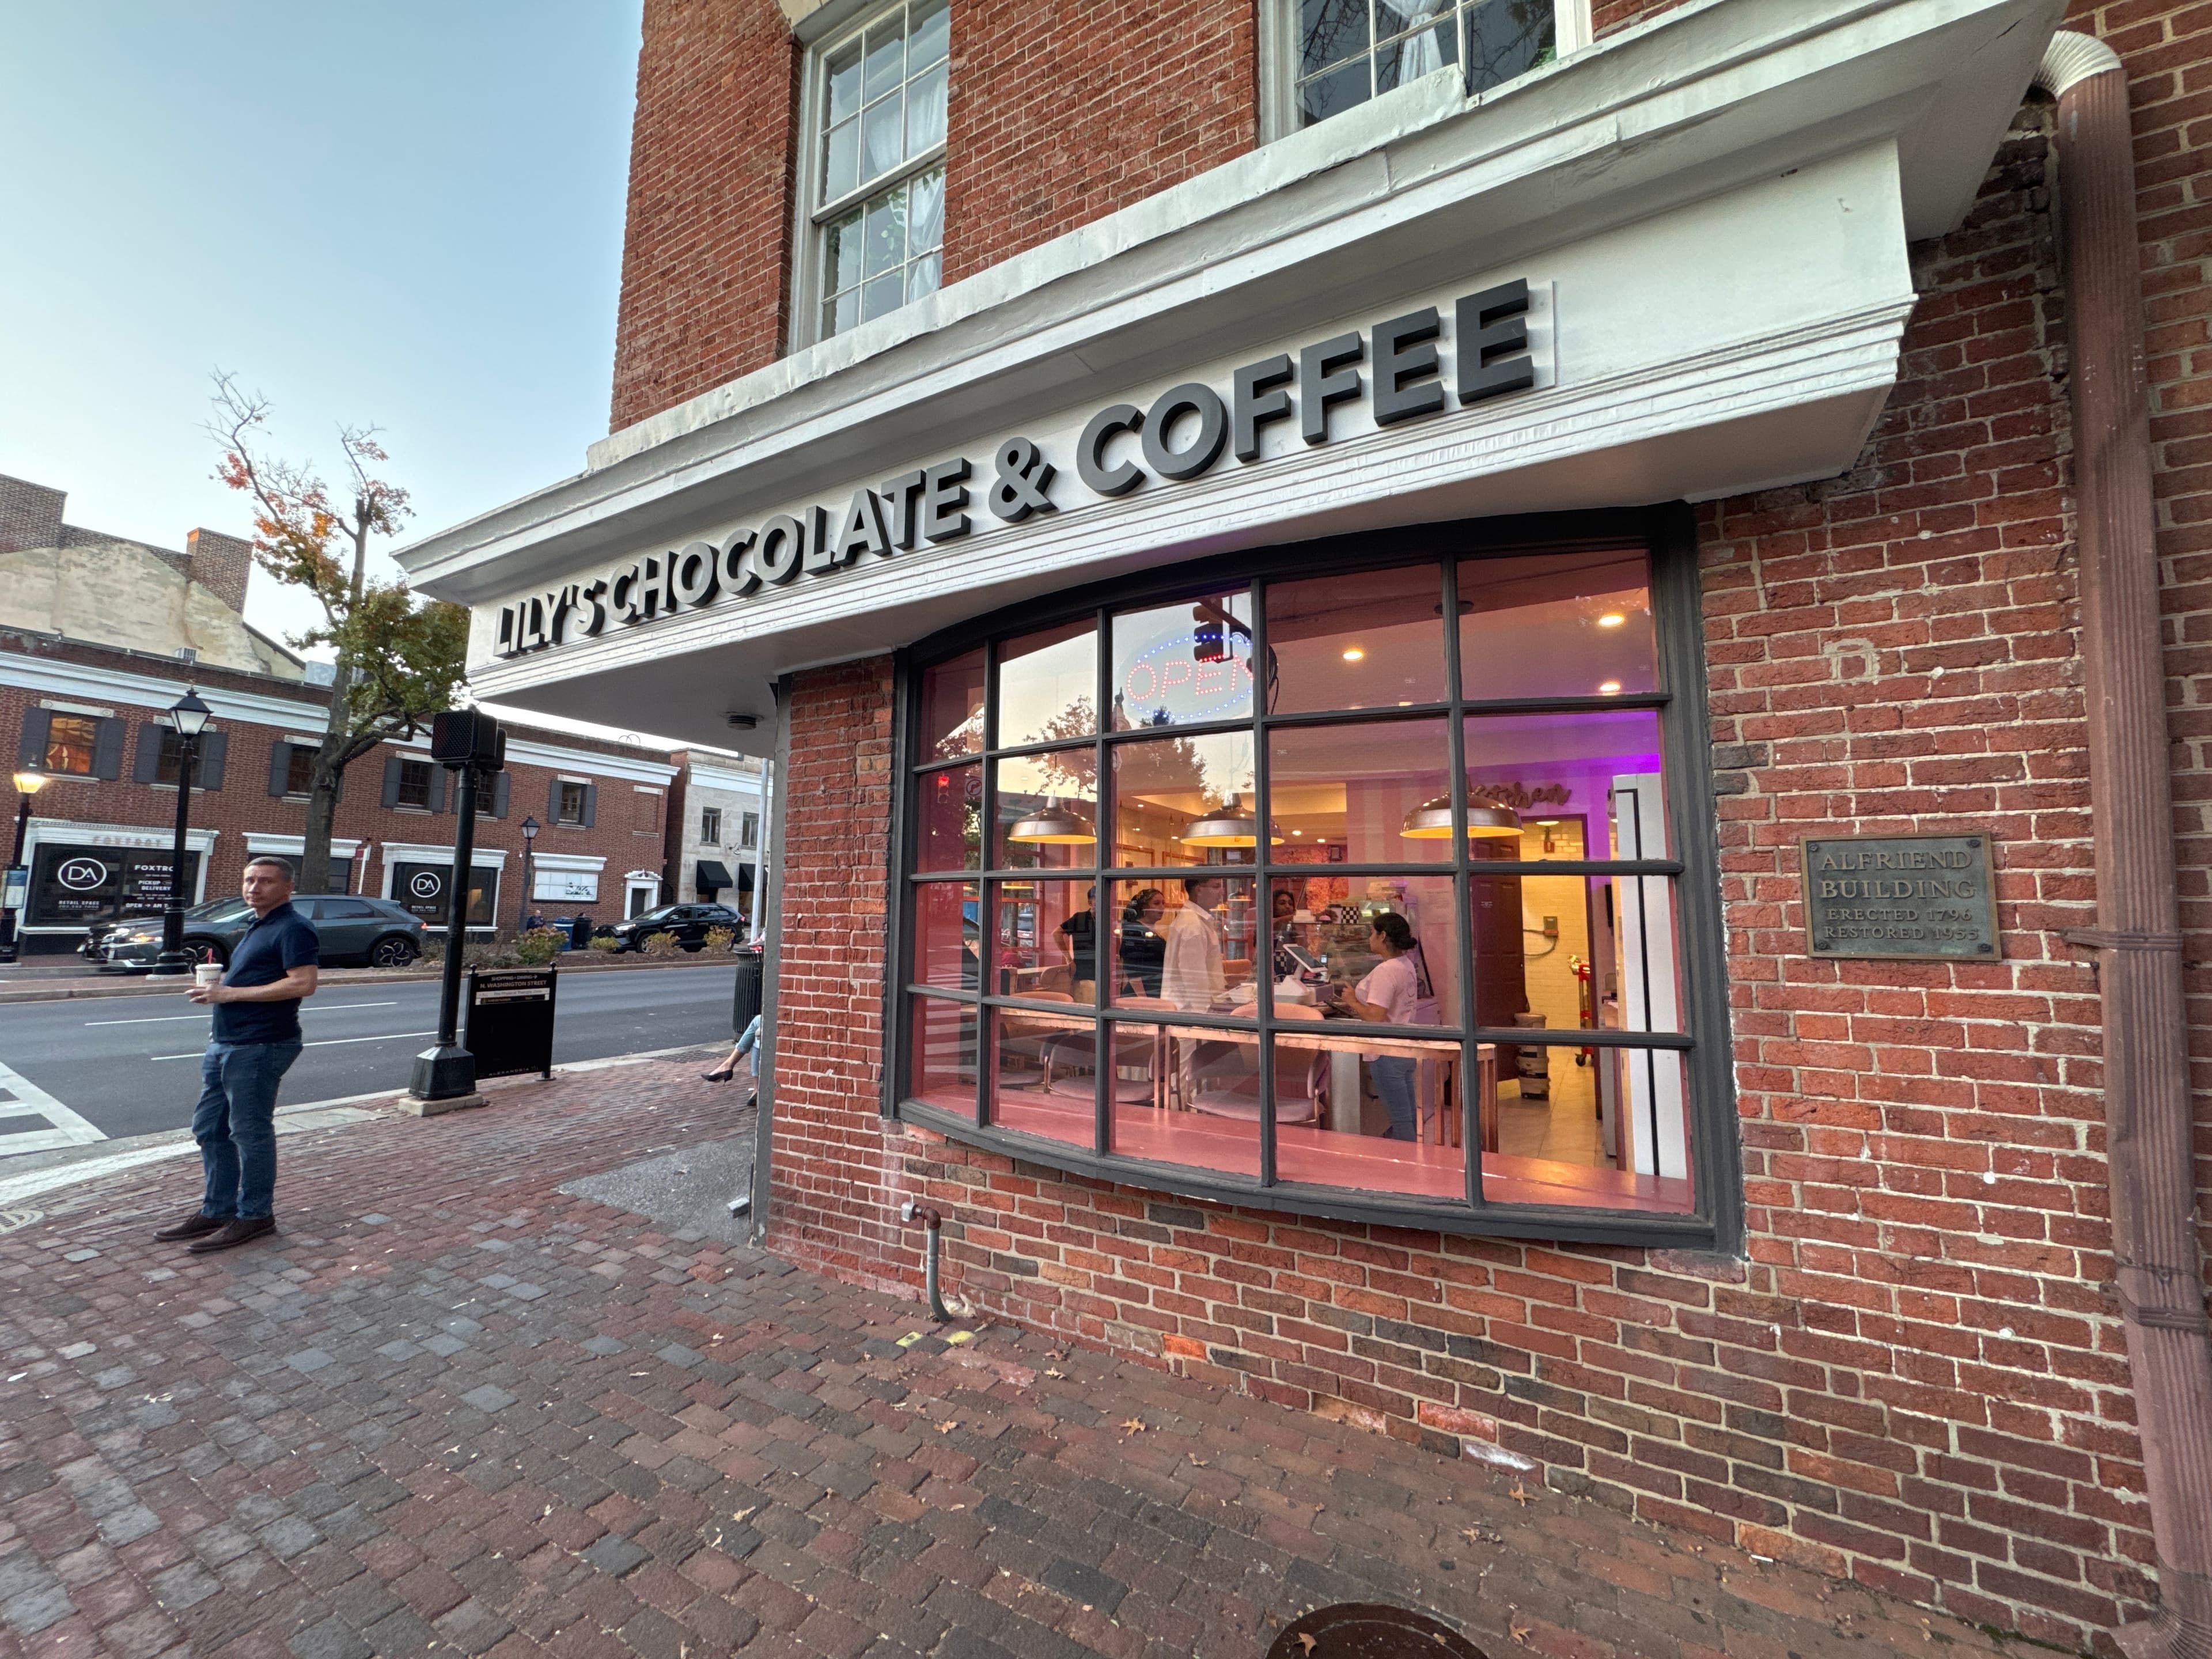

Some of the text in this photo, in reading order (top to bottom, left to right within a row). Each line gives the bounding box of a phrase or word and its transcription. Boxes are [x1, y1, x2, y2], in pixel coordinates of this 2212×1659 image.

[493, 278, 1536, 659] LILY'S CHOCOLATE & COFFEE
[1126, 653, 1255, 702] OPEN
[1820, 850, 1973, 872] ALFRIEND
[1820, 878, 1978, 899] BUILDING
[1827, 908, 1973, 923] ERECTED 1796
[1824, 925, 1980, 941] RESTORED 1955
